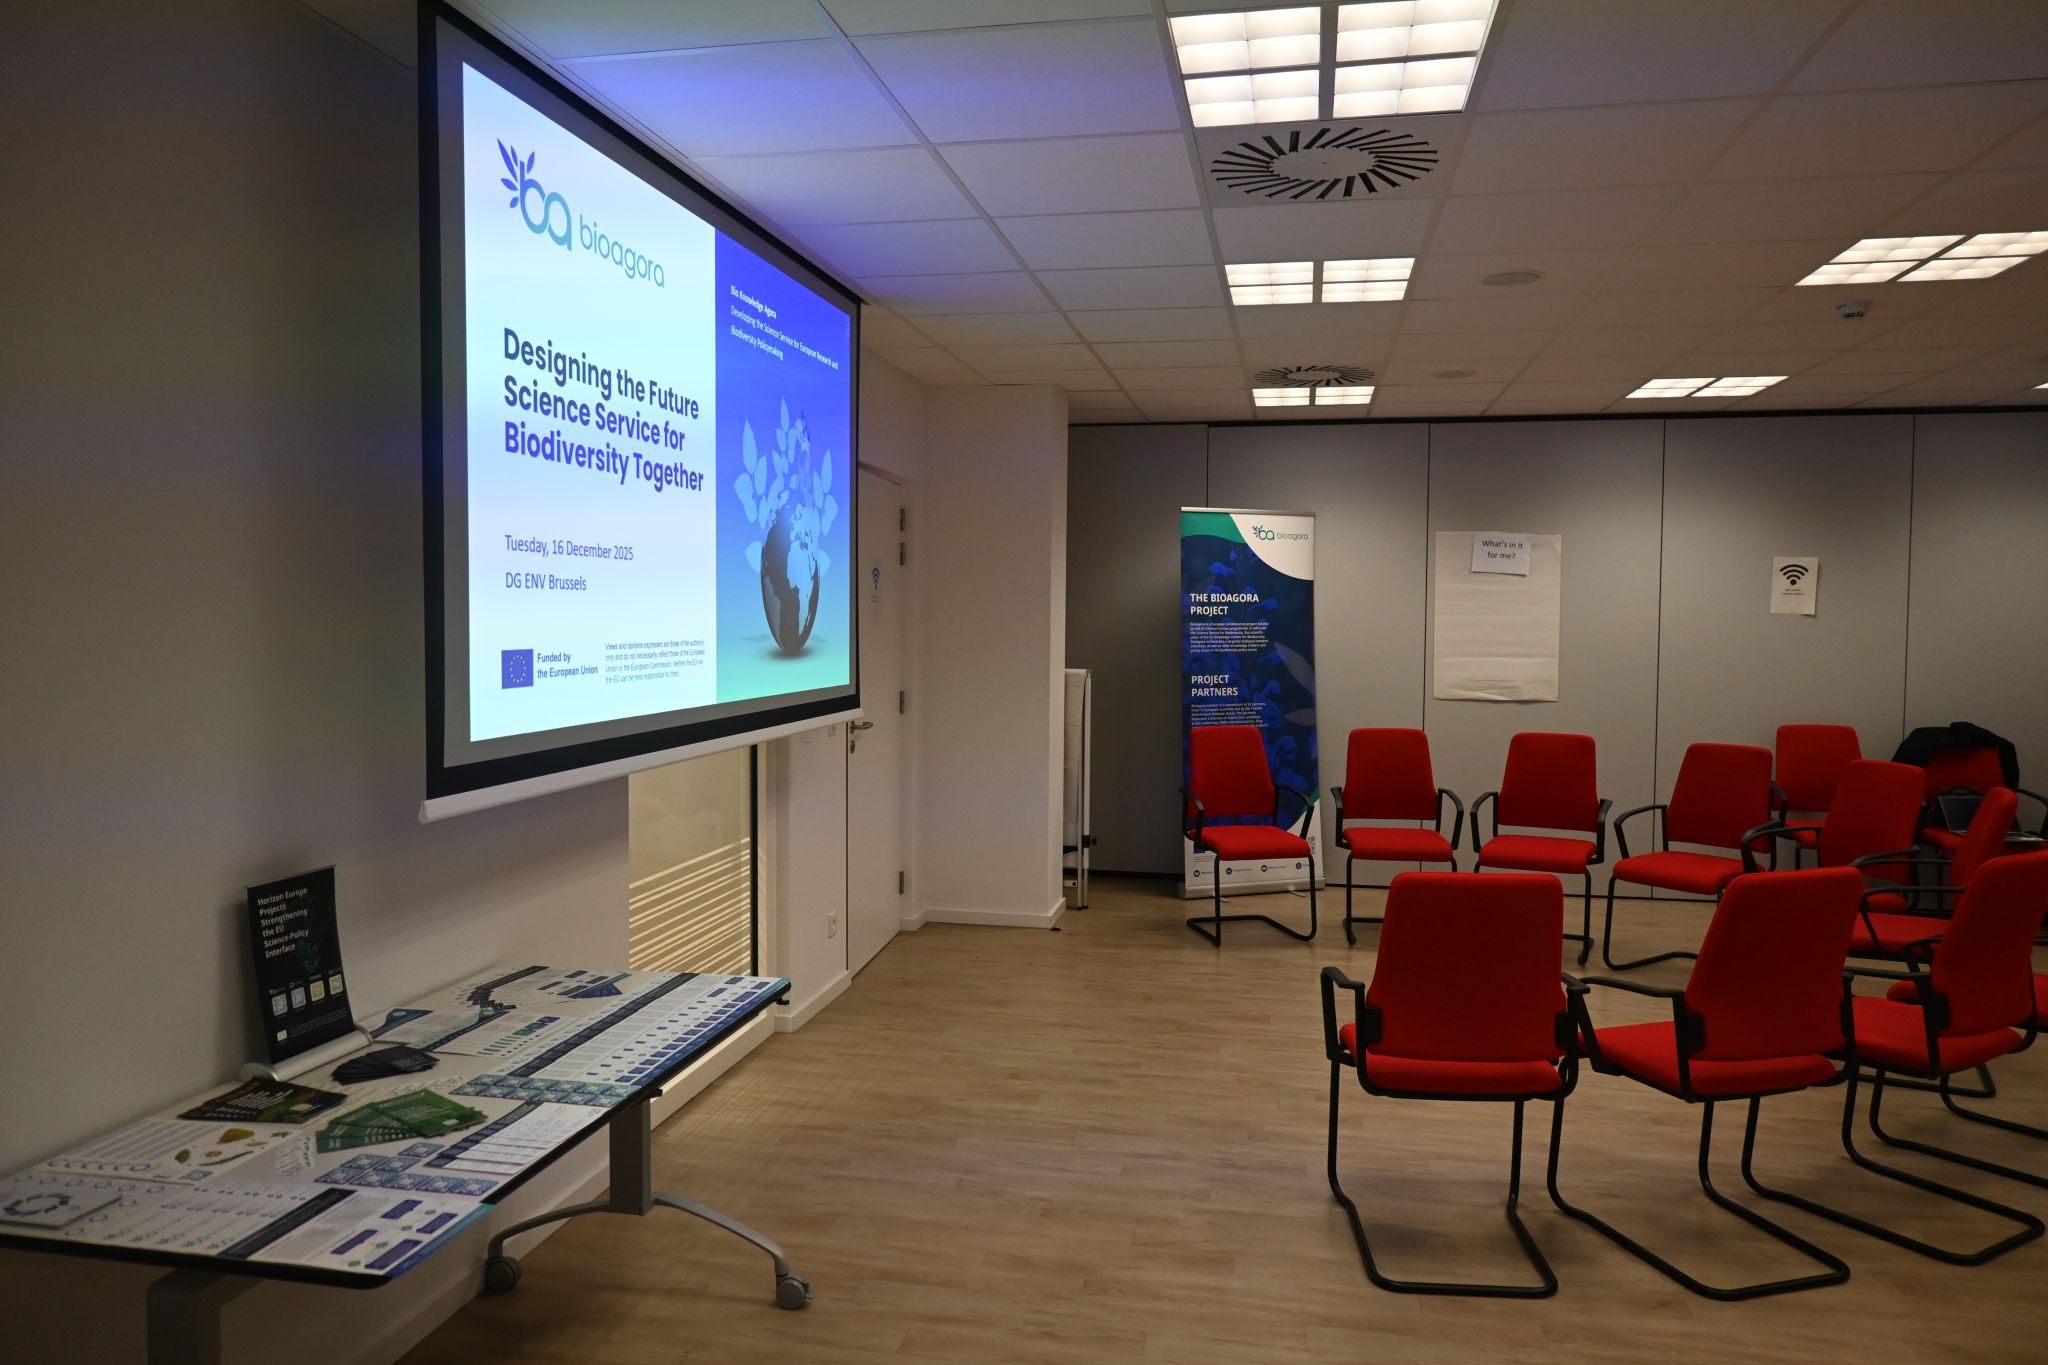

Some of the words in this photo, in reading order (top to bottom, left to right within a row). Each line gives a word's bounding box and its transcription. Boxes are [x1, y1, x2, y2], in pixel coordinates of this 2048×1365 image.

[580, 214, 664, 288] bioagora
[740, 290, 763, 312] Knowledge
[764, 304, 776, 319] Agora
[731, 305, 756, 329] Developing
[764, 323, 779, 338] Science
[779, 332, 794, 347] Service
[799, 342, 816, 359] European
[817, 352, 831, 366] Research
[731, 325, 757, 348] Biodiversity
[757, 338, 783, 361] Policymaking
[504, 327, 612, 401] Designing
[616, 368, 645, 402] the
[649, 380, 699, 420] Future
[504, 374, 591, 427] Science
[595, 402, 660, 445] Service
[664, 420, 685, 451] for
[505, 420, 629, 485] Biodiversity
[633, 452, 704, 492] Together
[1276, 531, 1309, 541] bioagora
[1482, 540, 1508, 548] What's
[1509, 541, 1517, 549] in
[1518, 541, 1524, 549] it
[504, 534, 549, 558] Tuesday,
[552, 540, 564, 555] 16
[566, 540, 612, 559] December
[613, 545, 634, 560] 2025
[1487, 551, 1498, 559] for
[1500, 552, 1516, 560] me?
[505, 572, 521, 589] DG
[525, 573, 546, 589] ENV
[549, 574, 587, 591] Brussels
[1190, 593, 1208, 602] THE
[1211, 593, 1260, 602] BIOAGORA
[1190, 606, 1229, 617] PROJECT
[537, 652, 561, 663] Funded
[563, 652, 571, 664] by
[537, 668, 548, 678] the
[549, 667, 579, 679] European
[580, 665, 598, 675] Union
[1191, 675, 1230, 685] PROJECT
[1191, 687, 1239, 697] PARTNERS
[257, 893, 284, 906] Horizon
[285, 887, 308, 900] Europe
[259, 903, 287, 916] Projects
[261, 908, 308, 927] Strengthening
[262, 928, 275, 938] the
[275, 924, 285, 934] EU
[264, 928, 309, 948] Science-Policy
[266, 943, 296, 959] Interface
